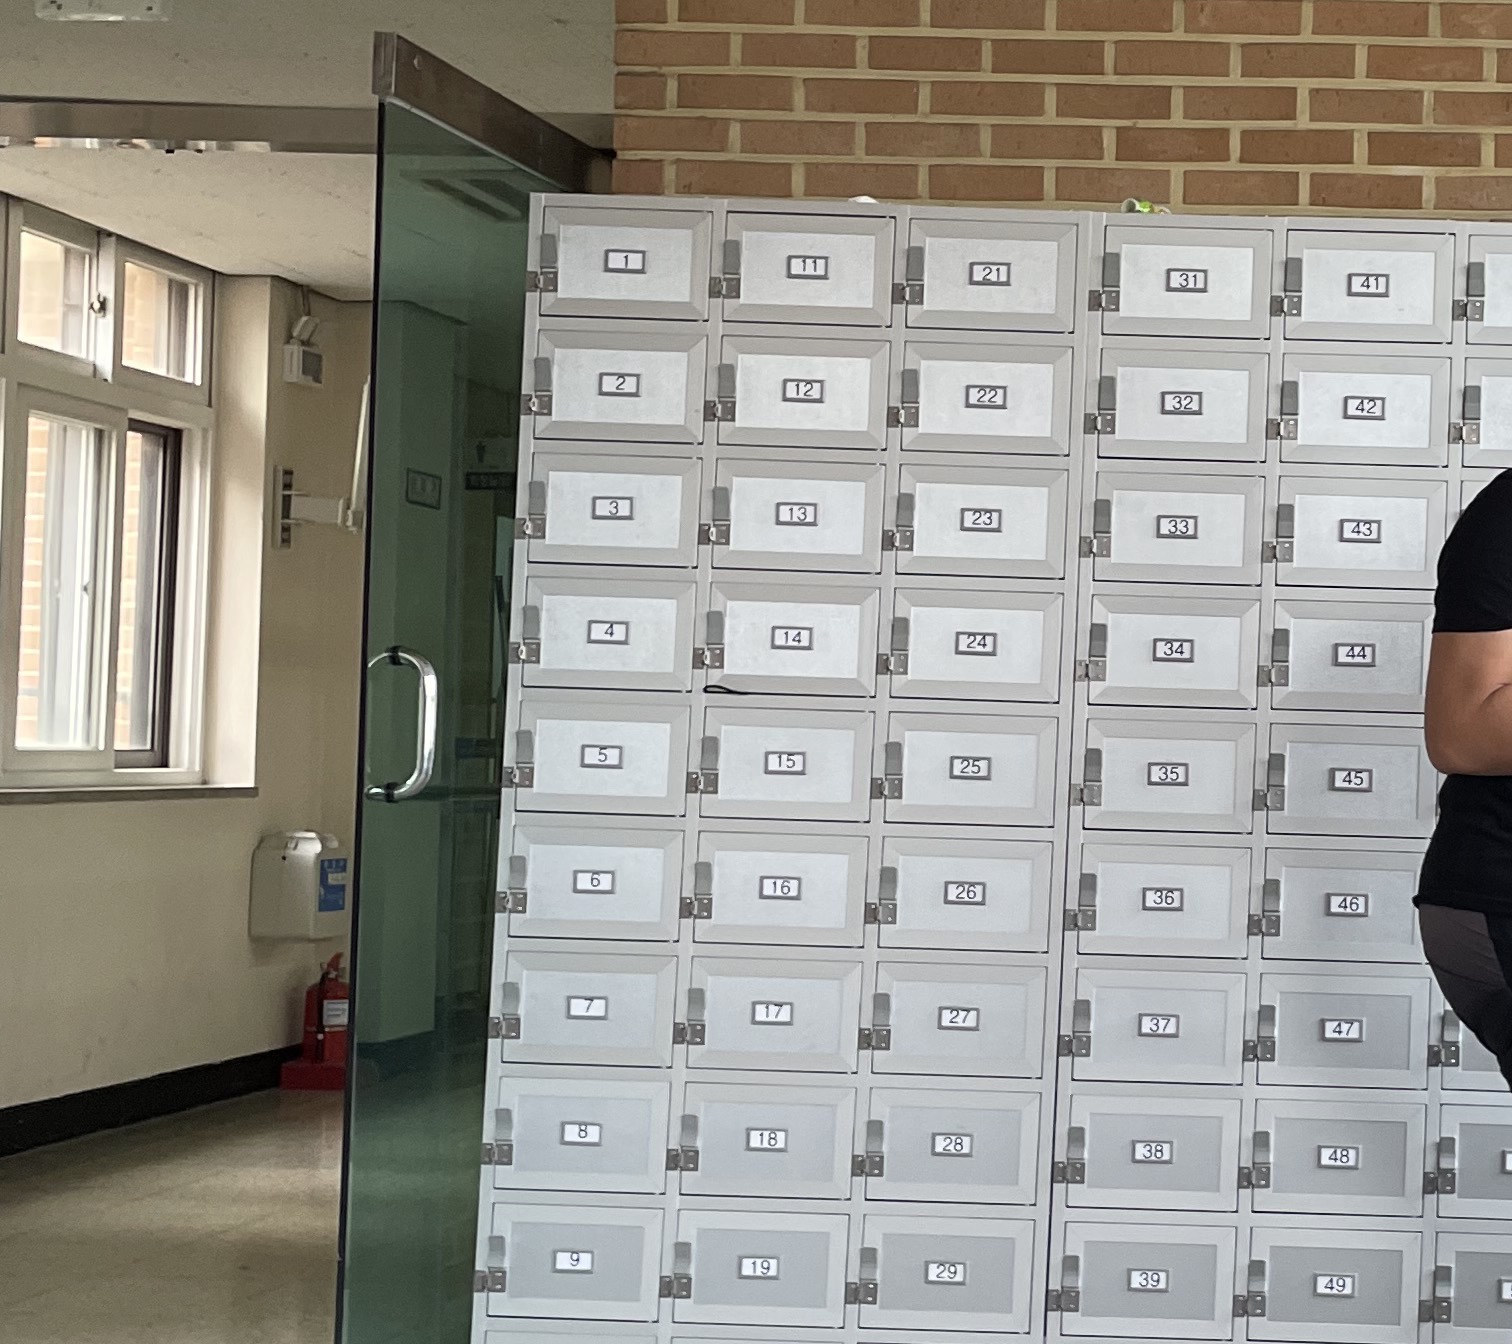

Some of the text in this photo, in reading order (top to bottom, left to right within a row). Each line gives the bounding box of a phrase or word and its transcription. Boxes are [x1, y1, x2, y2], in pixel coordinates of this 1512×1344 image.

[623, 254, 629, 268] 1
[802, 259, 817, 272] 11
[982, 266, 1001, 281] 21
[1179, 273, 1197, 288] 31
[1360, 276, 1379, 291] 41
[615, 376, 625, 391] 2
[795, 382, 814, 397] 12
[976, 388, 997, 403] 22
[1172, 395, 1193, 410] 32
[1355, 400, 1376, 414] 42
[609, 501, 619, 516] 3
[789, 507, 807, 521] 13
[972, 510, 993, 526] 23
[1168, 519, 1189, 535] 33
[1351, 522, 1373, 537] 43
[604, 623, 614, 637] 4
[784, 631, 802, 644] 14
[966, 635, 987, 649] 24
[1163, 641, 1185, 656] 34
[1345, 646, 1367, 660] 44
[597, 748, 608, 763] 5
[778, 754, 796, 769] 15
[960, 759, 981, 774] 25
[1158, 766, 1179, 782] 35
[1342, 771, 1364, 786] 45
[590, 873, 601, 887] 6
[772, 880, 791, 895] 16
[955, 884, 976, 900] 26
[1153, 890, 1175, 905] 36
[1338, 896, 1359, 911] 46
[584, 999, 594, 1013] 7
[765, 1004, 784, 1019] 17
[948, 1009, 971, 1024] 27
[1150, 1017, 1171, 1032] 37
[1332, 1022, 1354, 1036] 47
[578, 1124, 588, 1138] 8
[759, 1131, 777, 1147] 18
[943, 1136, 964, 1152] 28
[1143, 1143, 1164, 1160] 38
[1328, 1148, 1350, 1163] 48
[570, 1252, 580, 1266] 9
[751, 1260, 771, 1275] 19
[936, 1264, 957, 1279] 29
[1139, 1271, 1160, 1288] 39
[1324, 1277, 1346, 1292] 49
